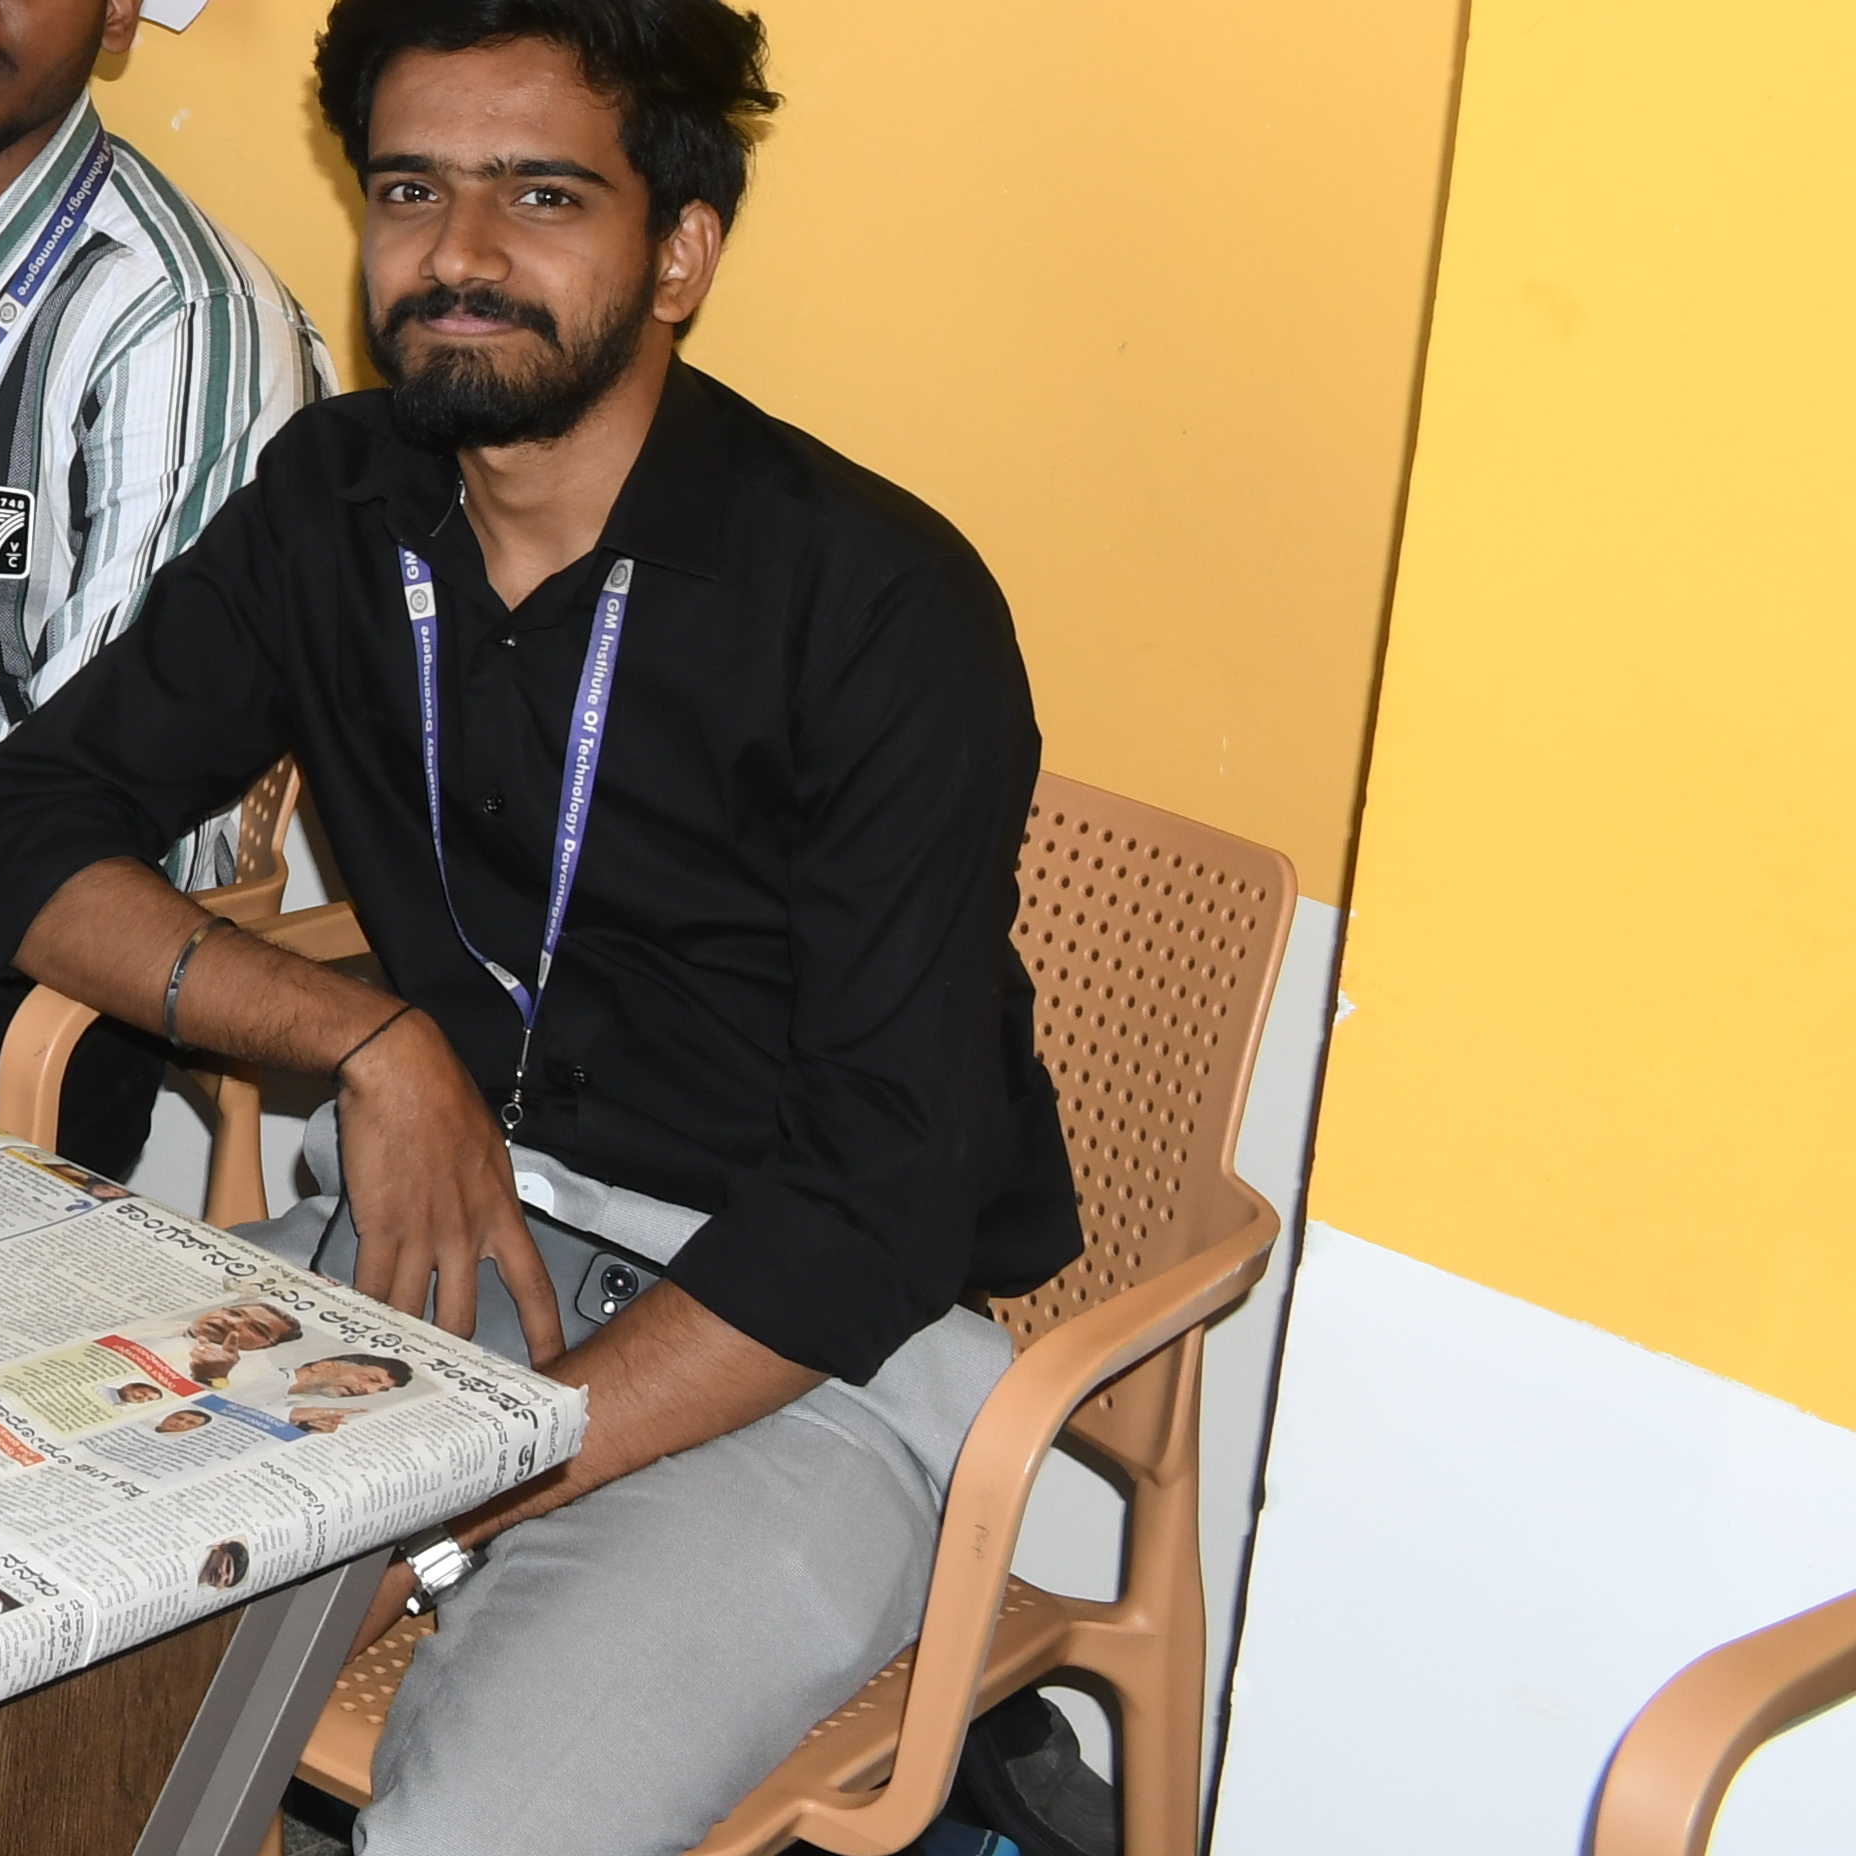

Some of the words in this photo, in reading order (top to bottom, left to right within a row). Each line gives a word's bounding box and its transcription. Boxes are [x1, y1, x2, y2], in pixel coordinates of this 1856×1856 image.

[67, 151, 110, 216] Technology
[17, 216, 74, 296] Davanagere
[405, 550, 419, 579] GM
[604, 598, 620, 629] GM
[420, 626, 434, 732] Davanagere
[587, 634, 614, 705] Institute
[582, 710, 598, 733] Of
[564, 737, 594, 835] Technology
[546, 838, 576, 946] Davanagere
[255, 1280, 316, 1314] ಸಿಎಂ
